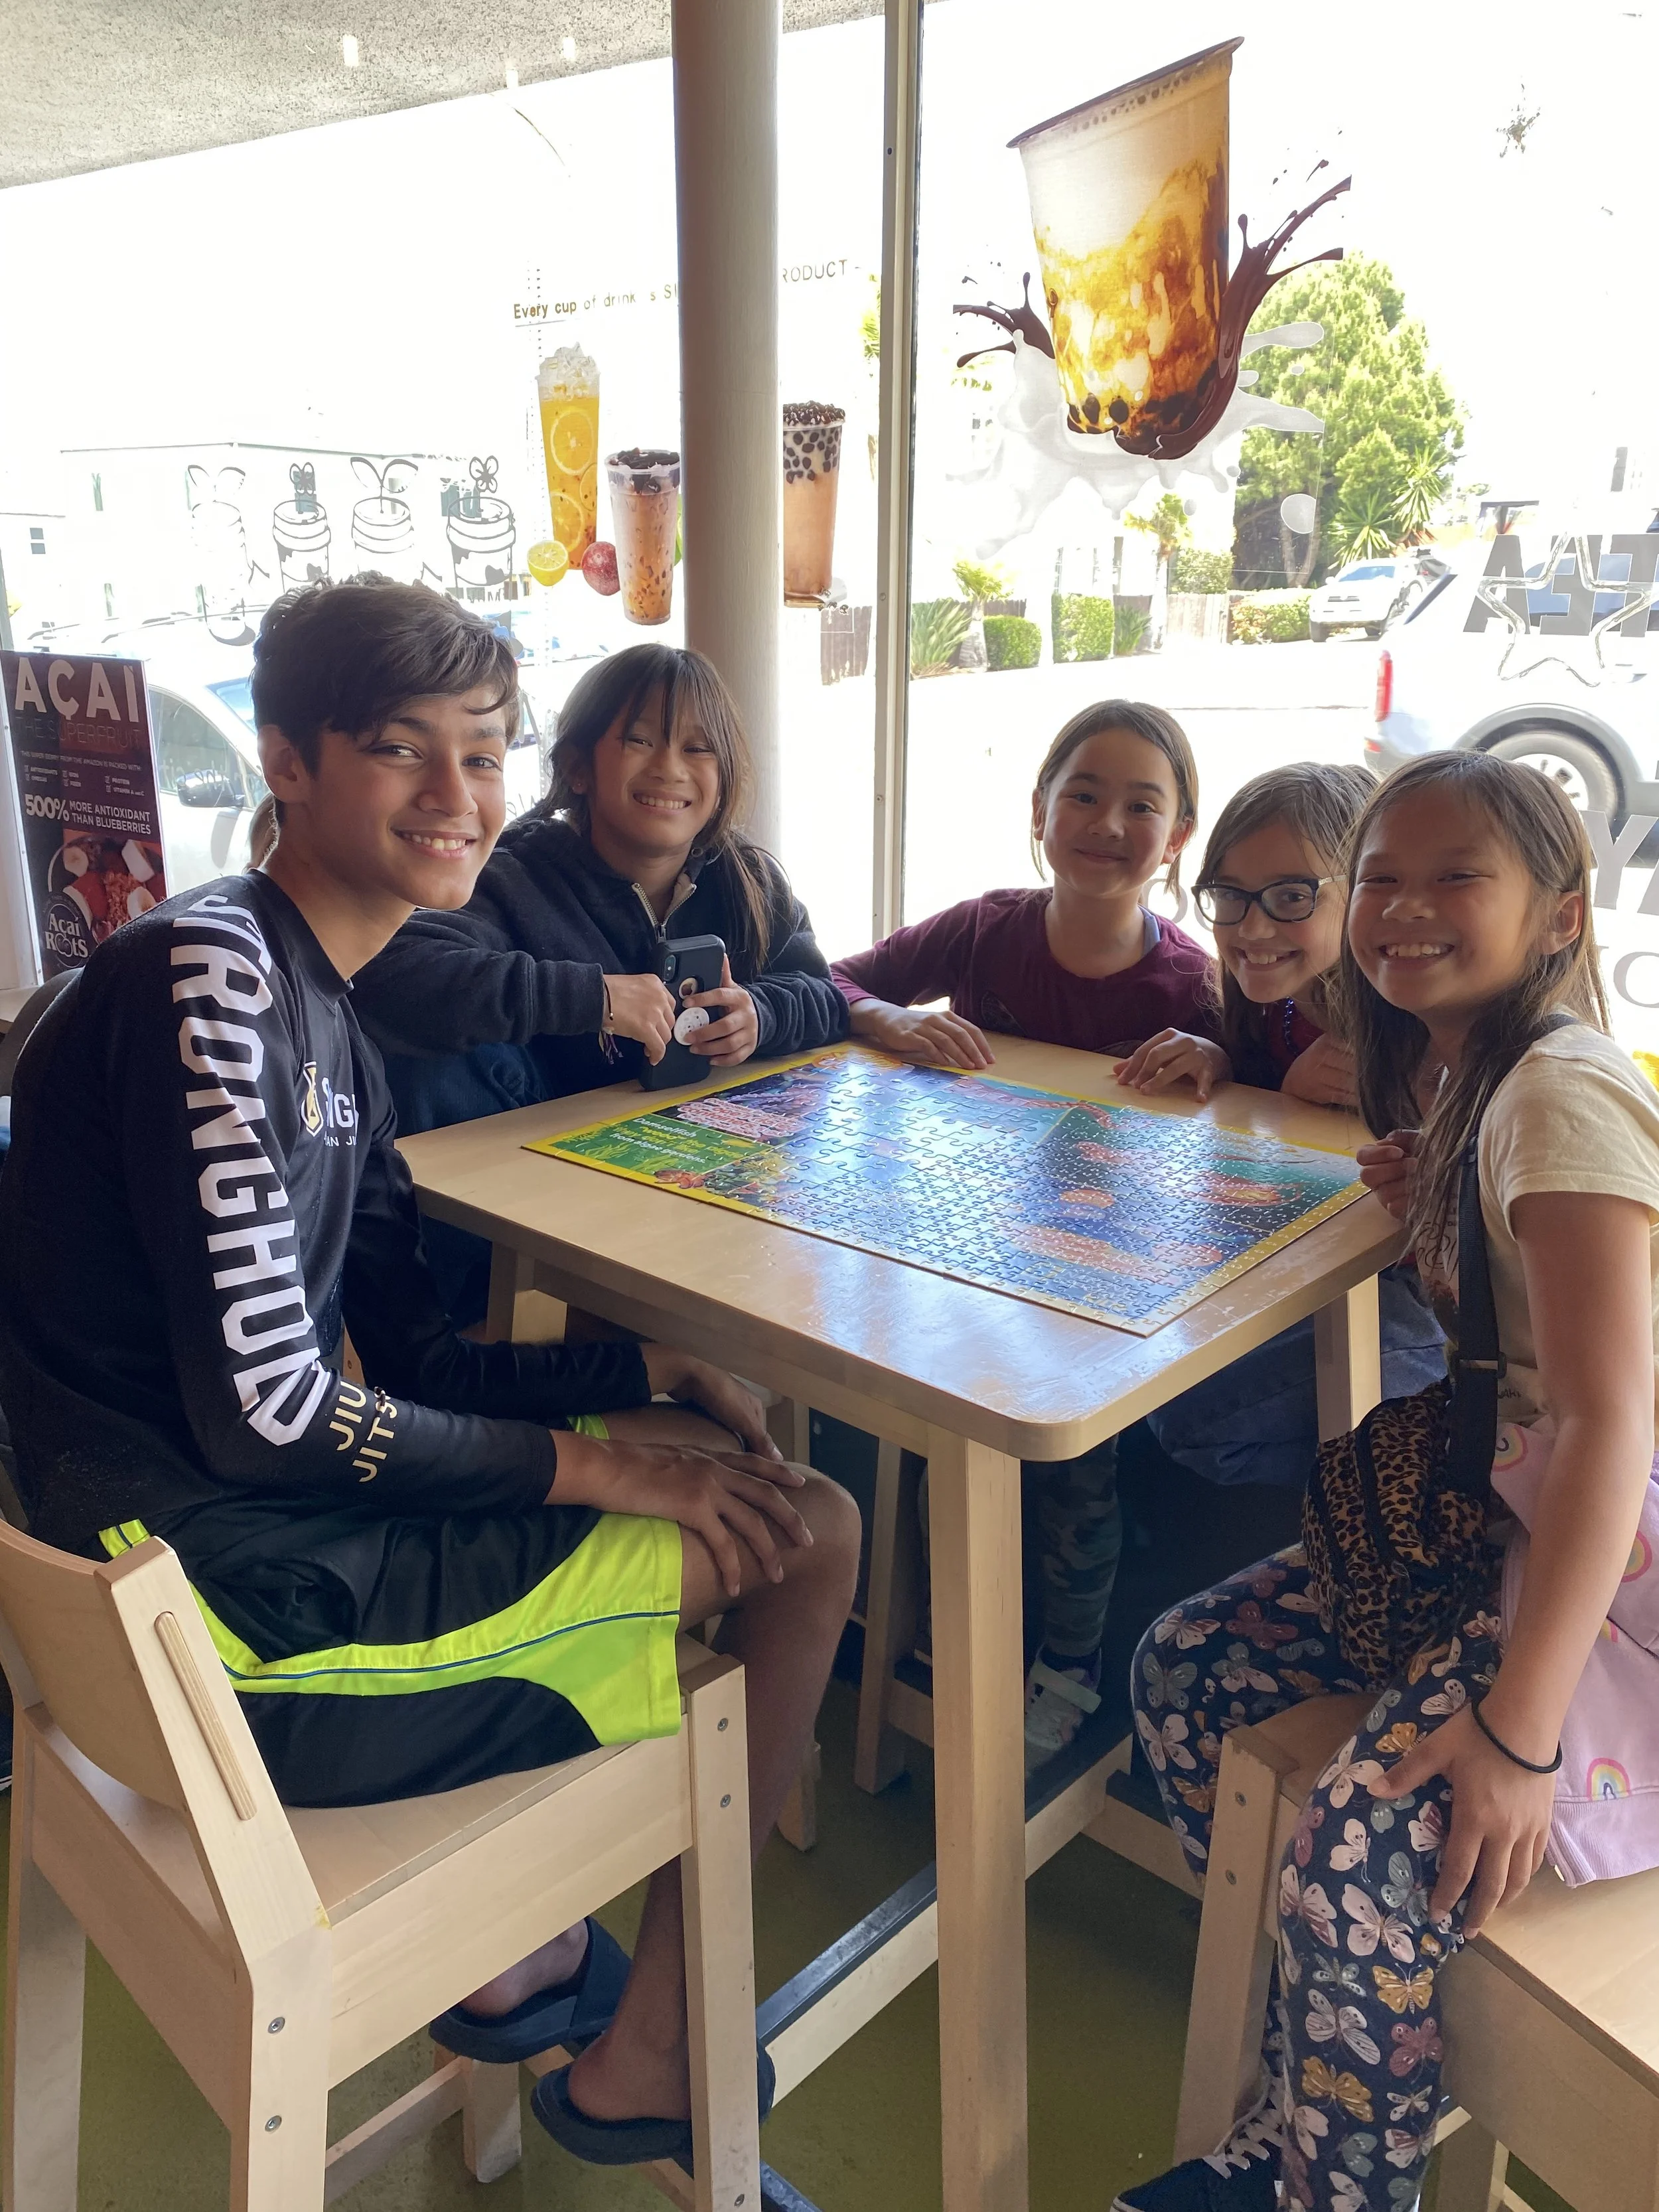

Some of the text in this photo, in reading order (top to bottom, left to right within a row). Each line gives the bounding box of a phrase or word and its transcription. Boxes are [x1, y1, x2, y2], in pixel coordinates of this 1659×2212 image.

[514, 302, 548, 319] Every
[555, 301, 577, 315] cup
[584, 295, 596, 310] of
[48, 719, 144, 750] SUPERFRUIT
[25, 794, 70, 822] 500%
[70, 800, 150, 822] MORE ANTIOXIDANT
[72, 812, 151, 835] THAN BLUEBERRIES
[632, 1118, 697, 1138] Damselfish
[609, 1132, 635, 1142] from
[633, 1140, 663, 1151] algae
[170, 894, 330, 1446] STRONGHOLD
[329, 1380, 367, 1451] JIU
